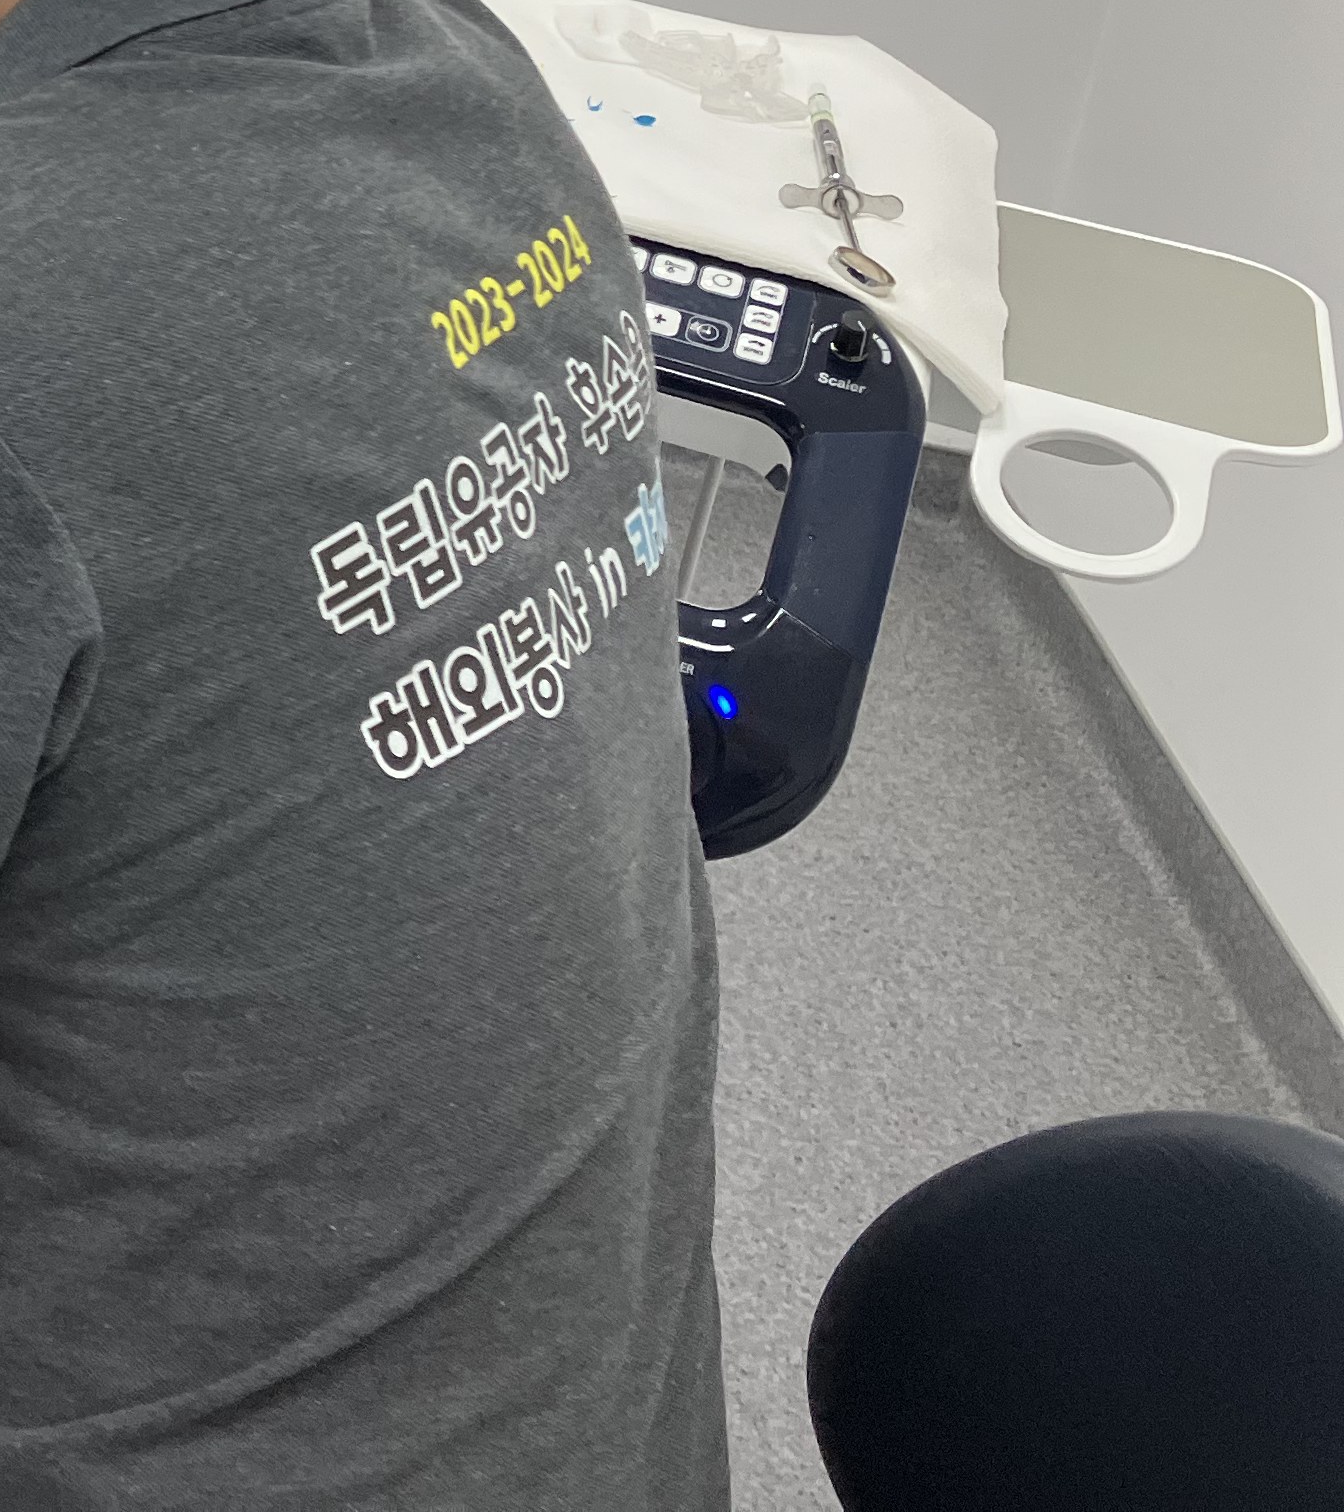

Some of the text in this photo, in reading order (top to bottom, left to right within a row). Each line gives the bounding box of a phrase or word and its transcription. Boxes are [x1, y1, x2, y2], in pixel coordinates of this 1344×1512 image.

[430, 214, 591, 370] 2023-2024
[817, 372, 868, 395] Scaler
[311, 391, 569, 636] 독립유공자
[359, 559, 591, 780] 해외봉사
[586, 546, 629, 617] in
[679, 661, 695, 676] ER
